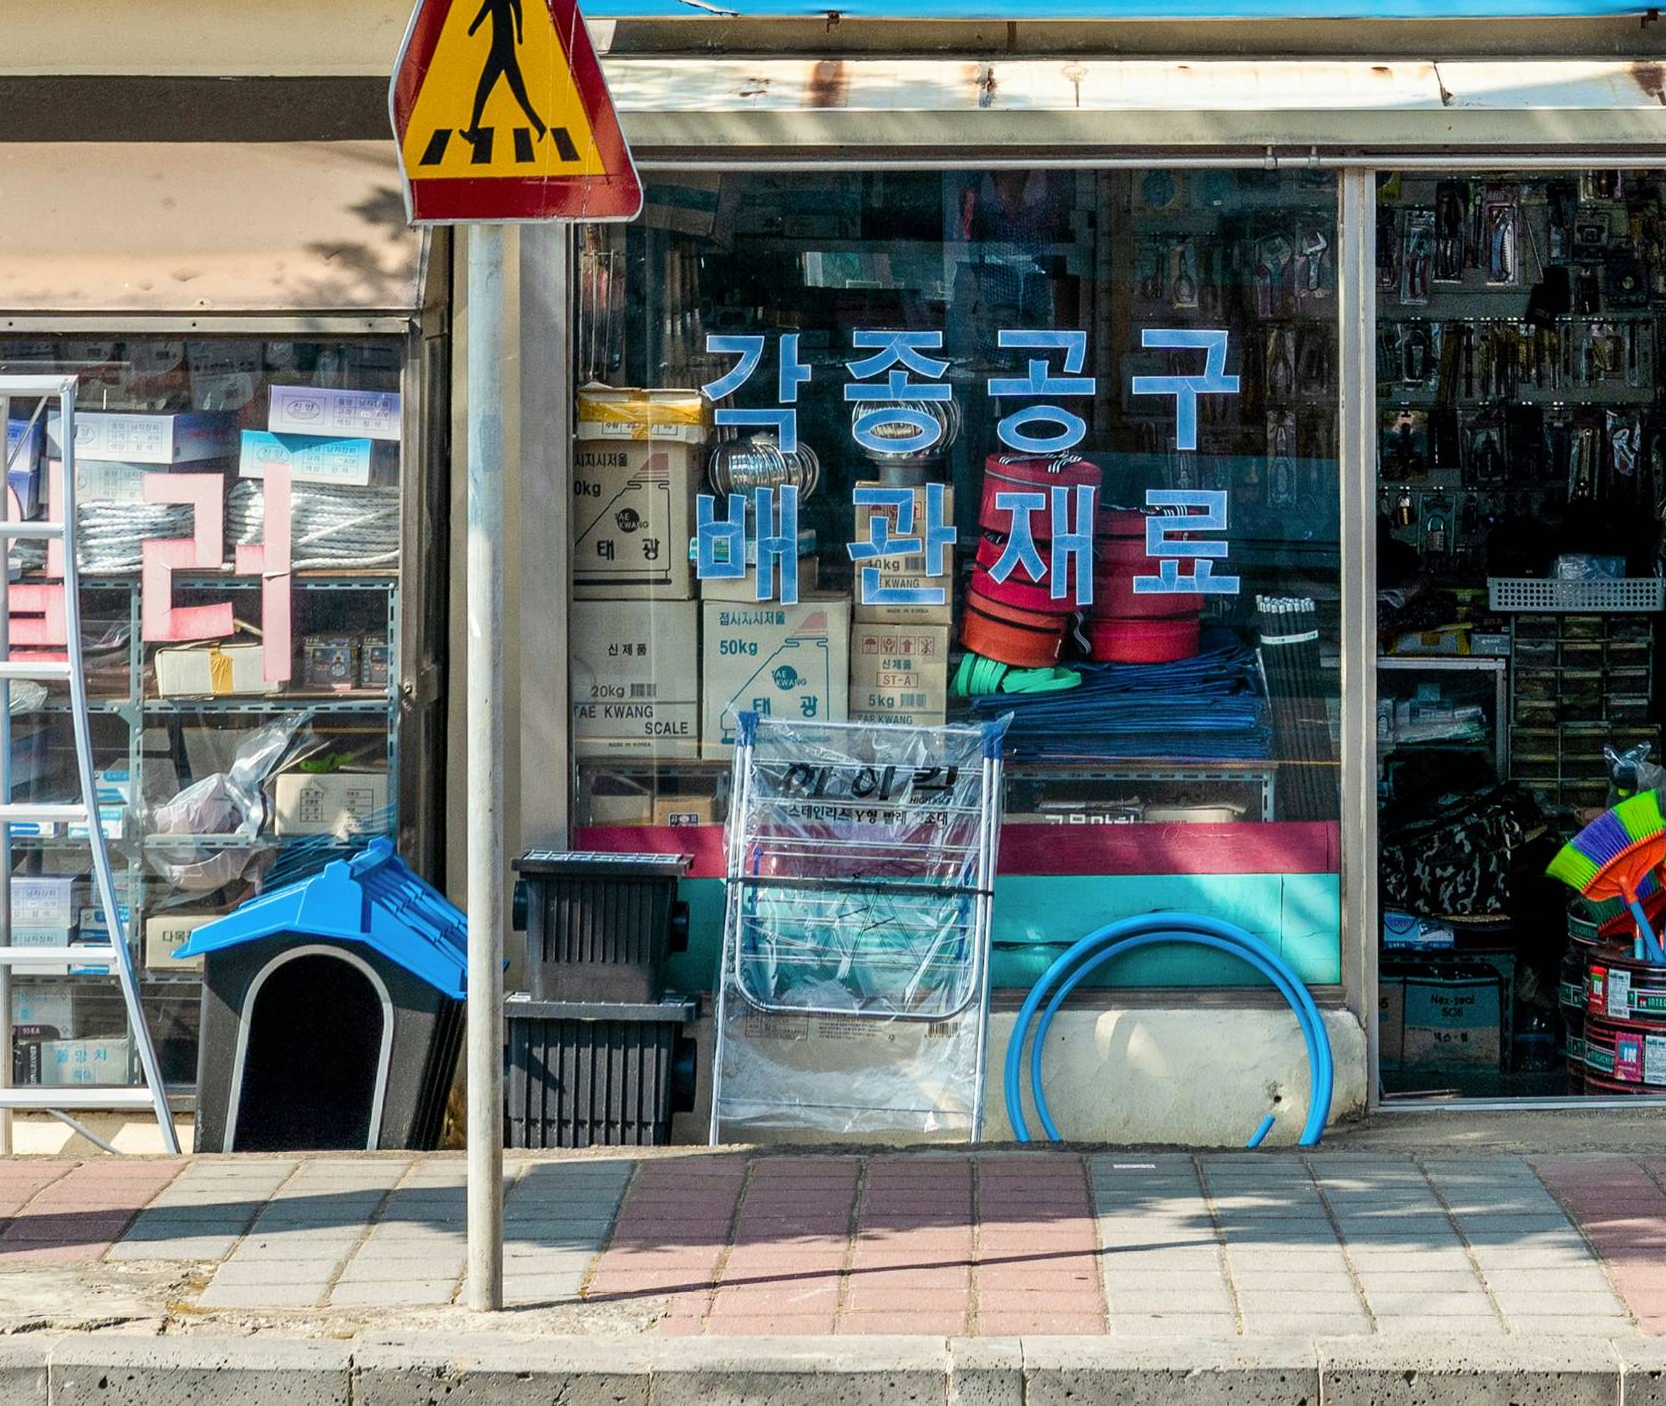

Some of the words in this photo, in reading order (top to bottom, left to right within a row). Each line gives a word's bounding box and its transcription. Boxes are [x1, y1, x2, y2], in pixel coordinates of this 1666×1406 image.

[700, 328, 1241, 456] 각종공구
[696, 482, 1241, 607] 배관재료
[884, 578, 920, 589] KWANG
[719, 610, 785, 627] 접시지시저울
[608, 642, 648, 657] 신제품
[719, 640, 759, 656] 50kg
[882, 659, 912, 671] 신제품
[774, 678, 808, 687] KWANG
[882, 674, 912, 686] ST-A
[591, 684, 625, 700] 20kg
[868, 694, 895, 708] 5kg
[604, 705, 654, 720] KWANG
[644, 721, 689, 735] SCALE
[788, 805, 851, 822] 스테인리스
[855, 808, 878, 823] Y형
[883, 811, 907, 825] 빨래
[162, 929, 193, 943] 다목
[55, 1049, 108, 1064] 돌망치
